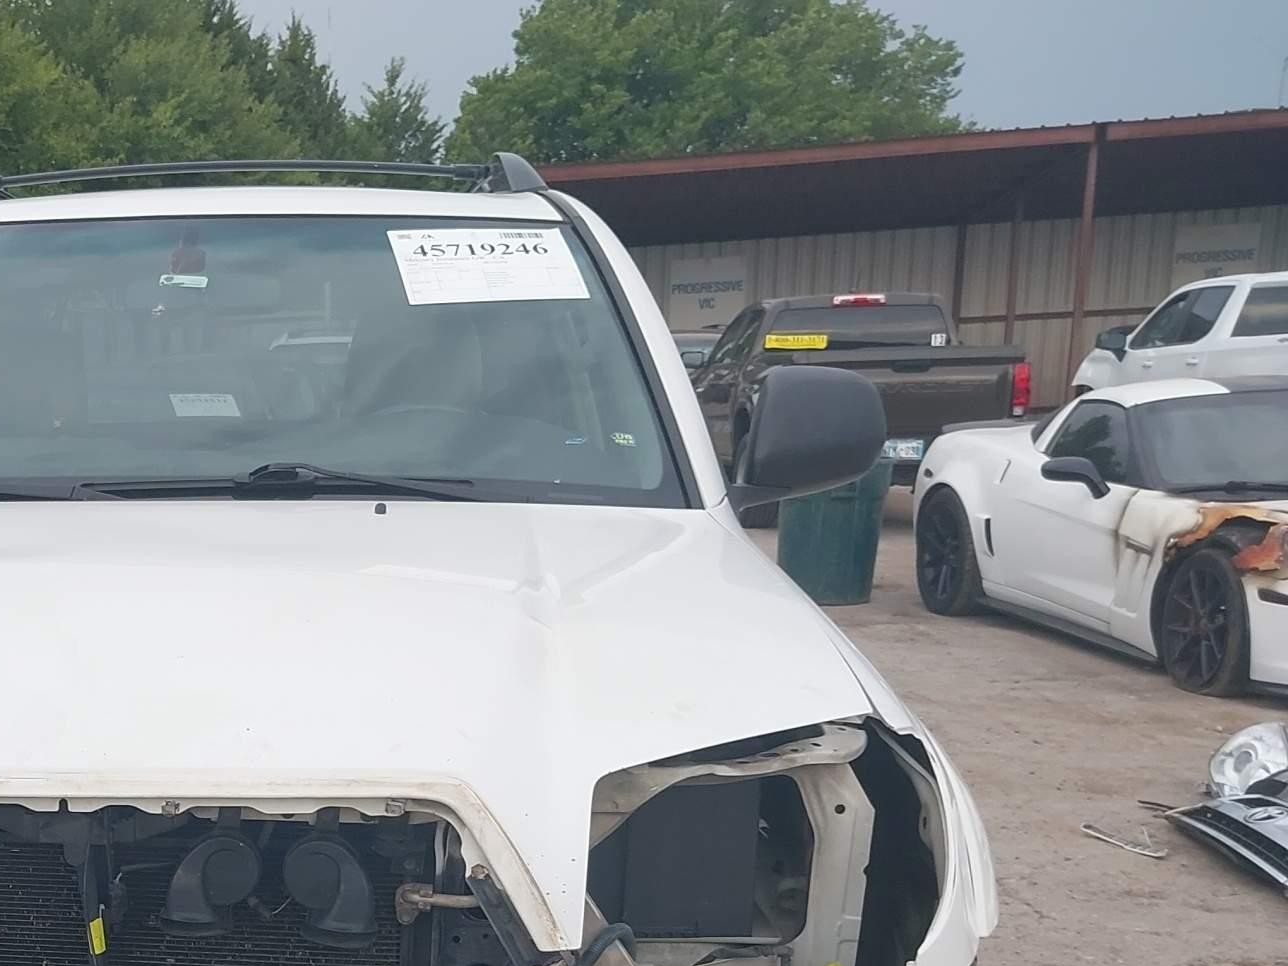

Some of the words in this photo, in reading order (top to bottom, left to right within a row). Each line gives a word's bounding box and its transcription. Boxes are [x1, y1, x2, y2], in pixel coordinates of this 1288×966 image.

[412, 242, 549, 257] 45719246
[1175, 248, 1257, 264] PROGRESSIVE
[671, 280, 744, 295] PROGRESSIVE
[697, 298, 715, 310] VIC
